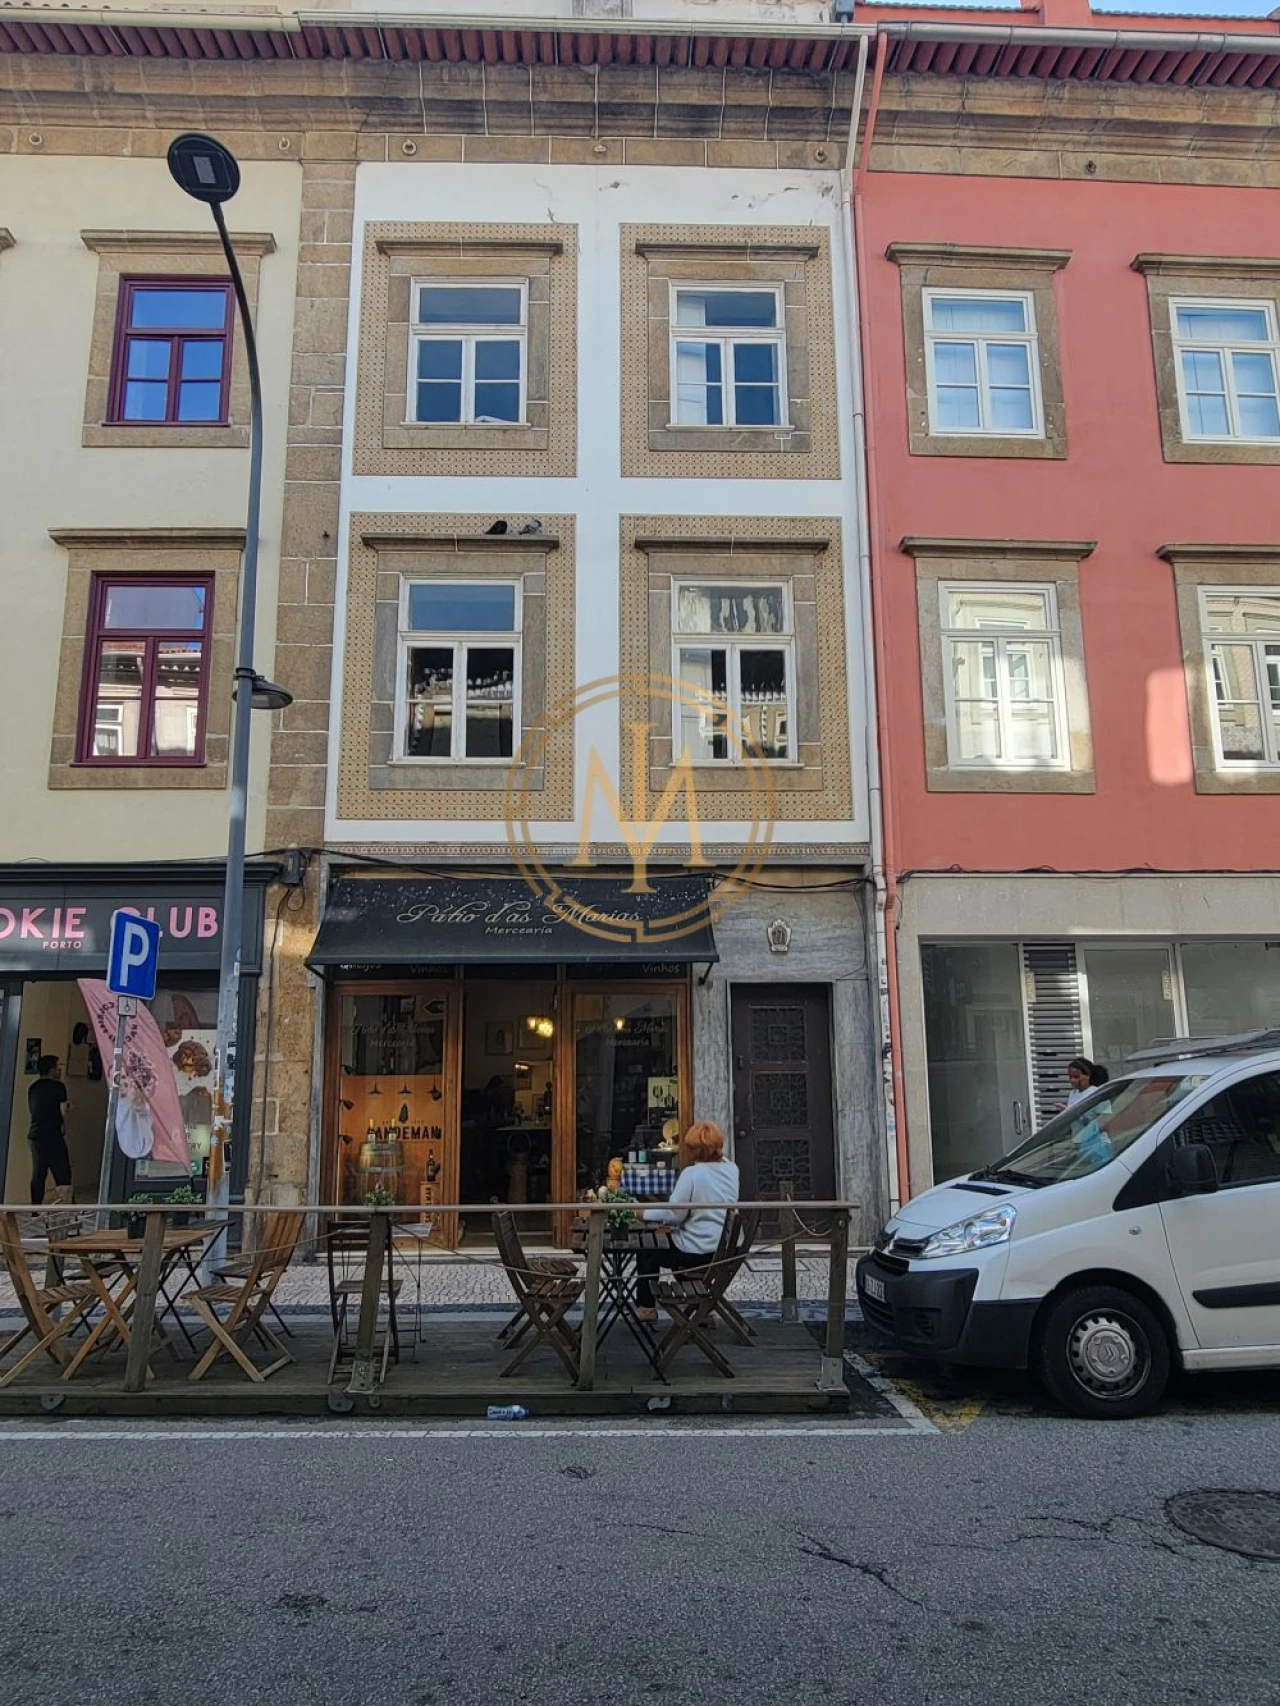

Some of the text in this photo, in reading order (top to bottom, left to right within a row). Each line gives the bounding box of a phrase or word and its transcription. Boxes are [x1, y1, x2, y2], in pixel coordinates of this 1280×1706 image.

[542, 903, 643, 925] Marias
[485, 925, 554, 935] Mercearia
[42, 940, 82, 949] PORTO
[119, 921, 150, 987] P
[367, 1126, 441, 1140] ANDEMAN
